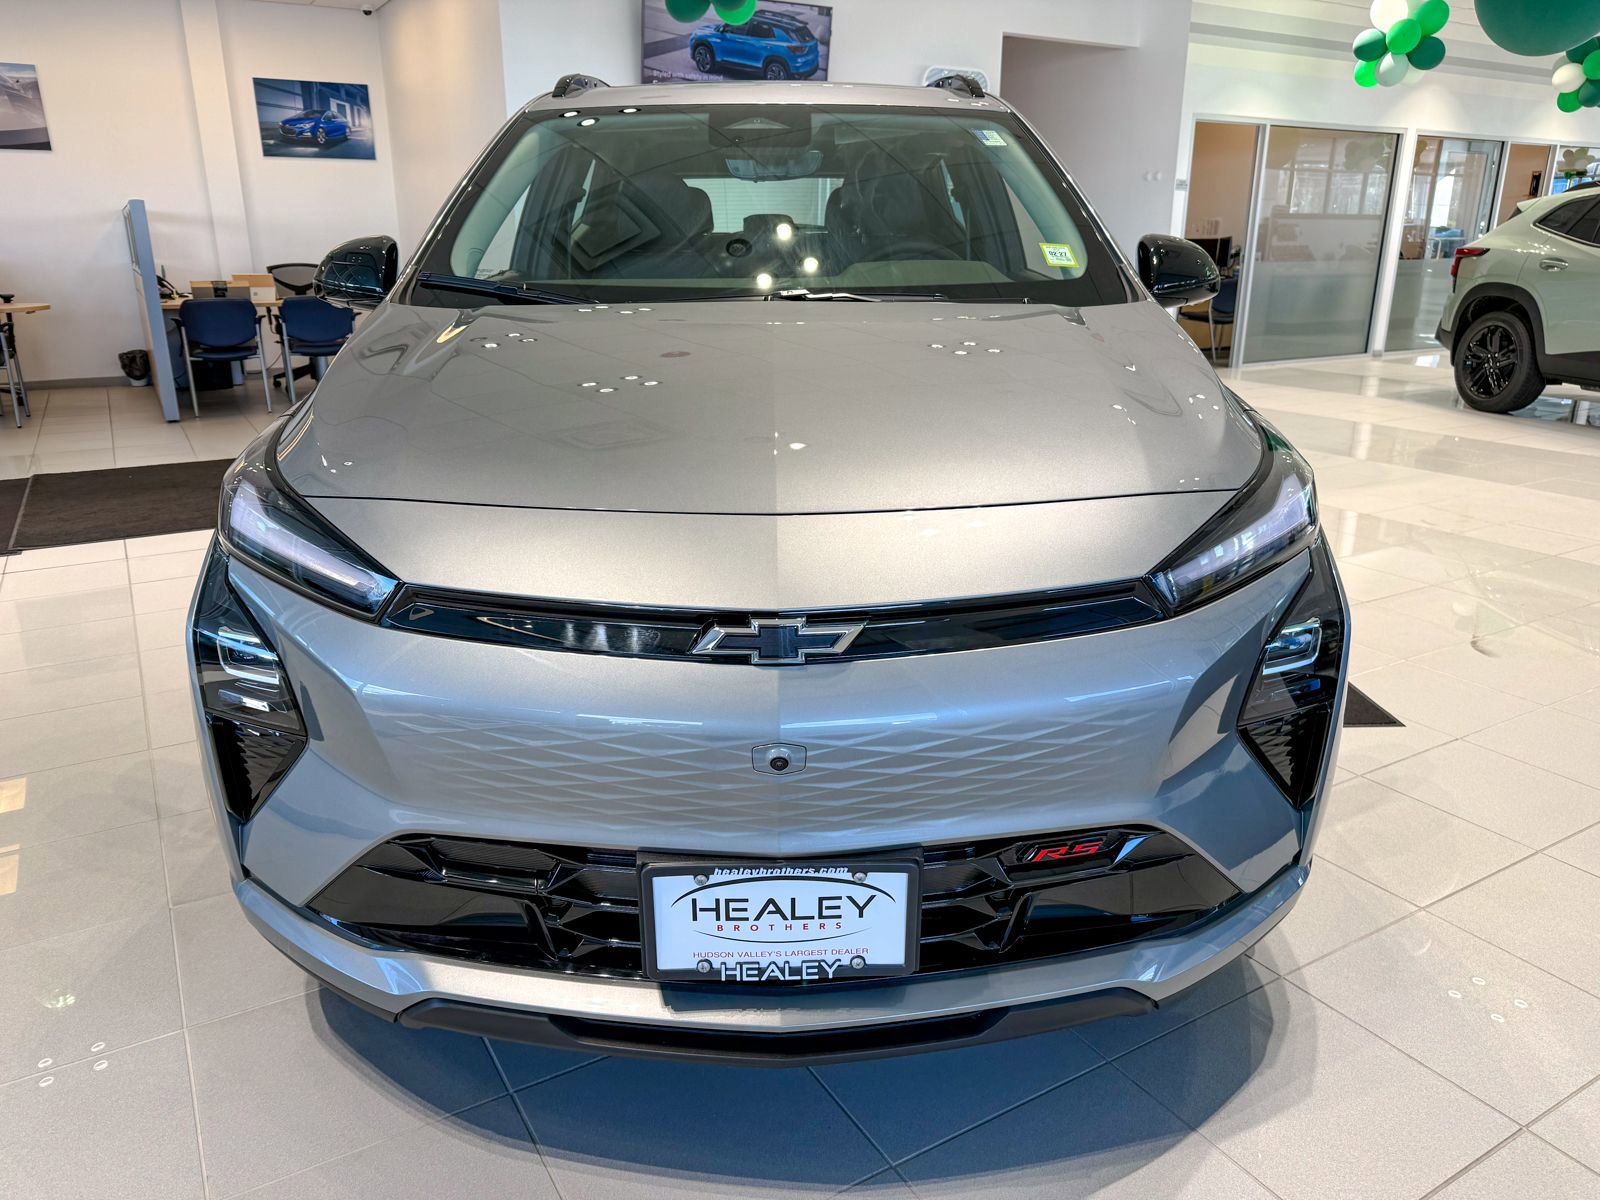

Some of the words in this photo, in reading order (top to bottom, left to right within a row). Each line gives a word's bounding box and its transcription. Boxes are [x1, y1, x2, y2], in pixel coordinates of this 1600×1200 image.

[1032, 841, 1104, 862] RS
[691, 894, 877, 922] HEALEY
[716, 922, 842, 932] BROTHERS
[693, 951, 734, 959] HUDSON
[737, 950, 782, 958] VALLEY'S
[785, 949, 828, 957] LARGEST
[831, 947, 869, 956] DEALER
[719, 960, 841, 982] HEALEY
